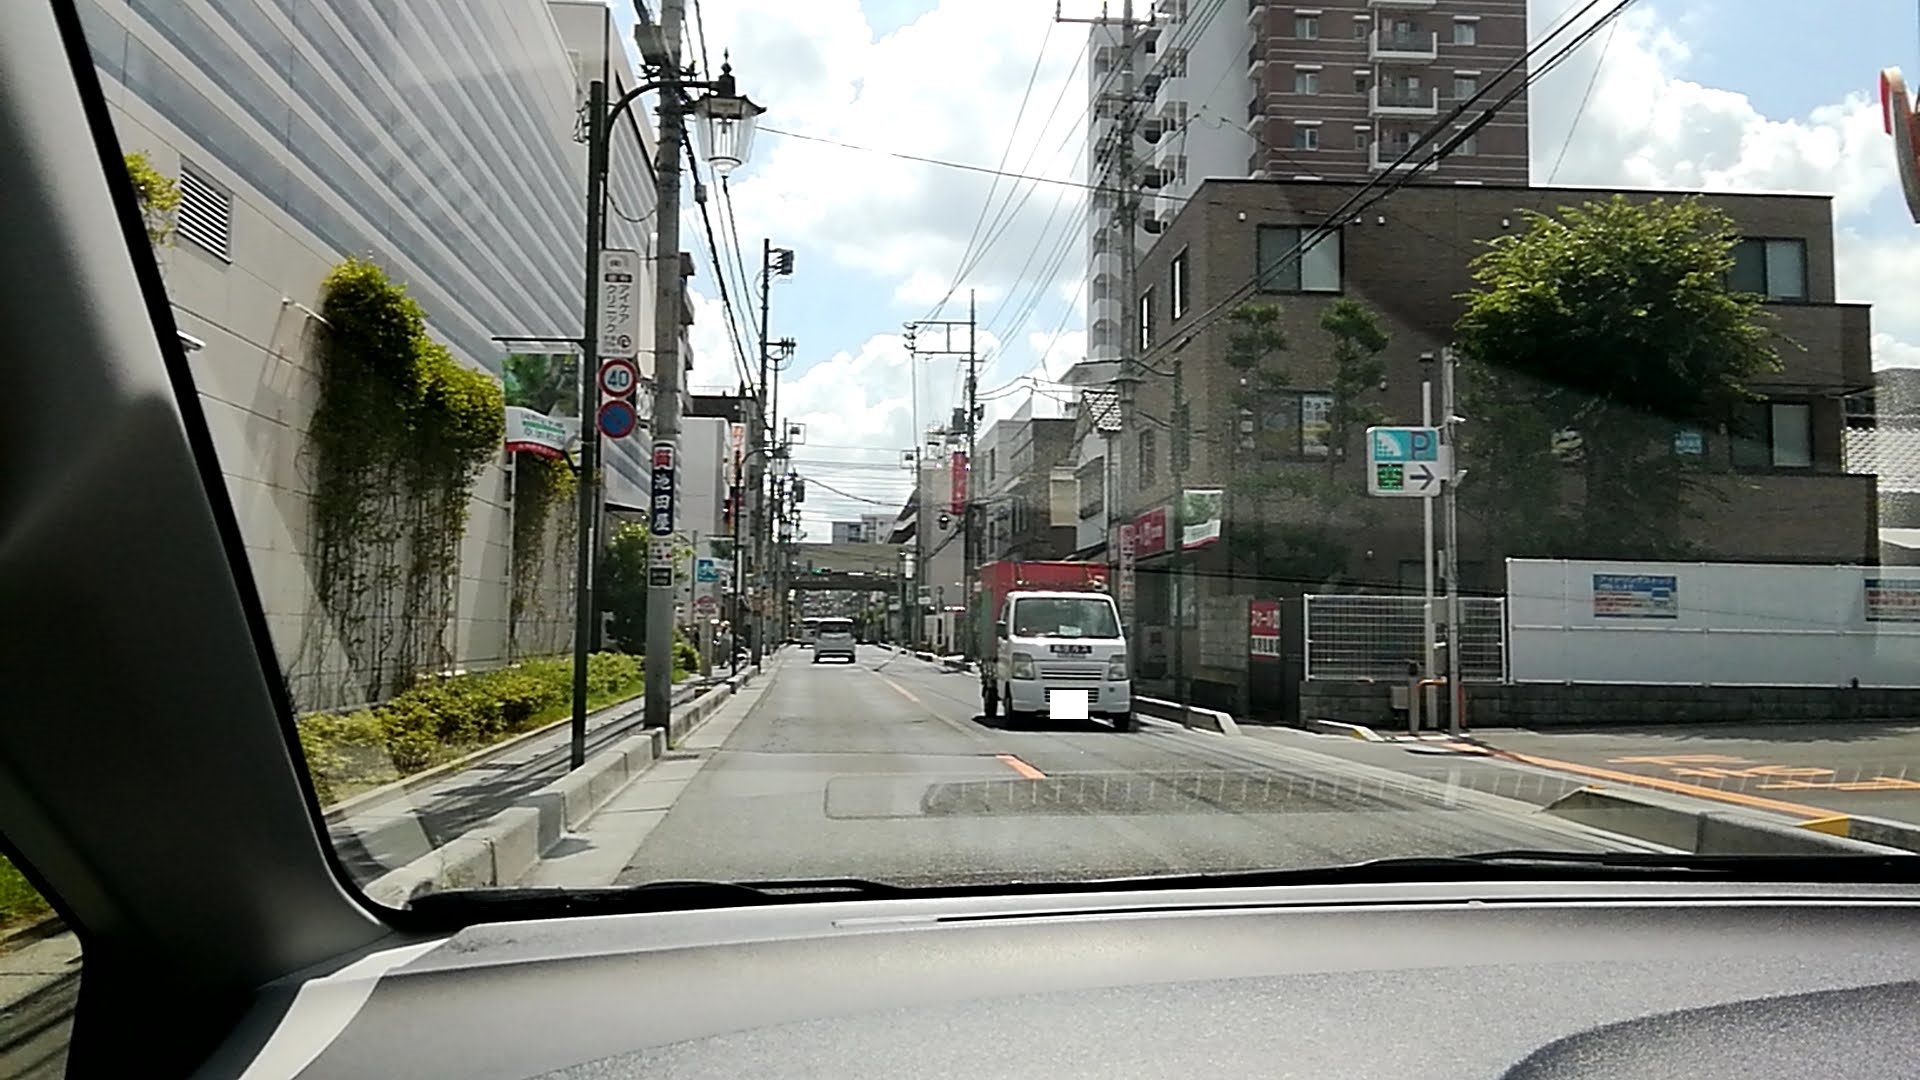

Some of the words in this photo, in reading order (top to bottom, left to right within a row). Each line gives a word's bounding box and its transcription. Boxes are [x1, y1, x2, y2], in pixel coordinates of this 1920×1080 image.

[606, 285, 617, 333] クリニック
[619, 285, 630, 324] アイケア
[607, 370, 629, 387] 40
[1411, 431, 1430, 460] P
